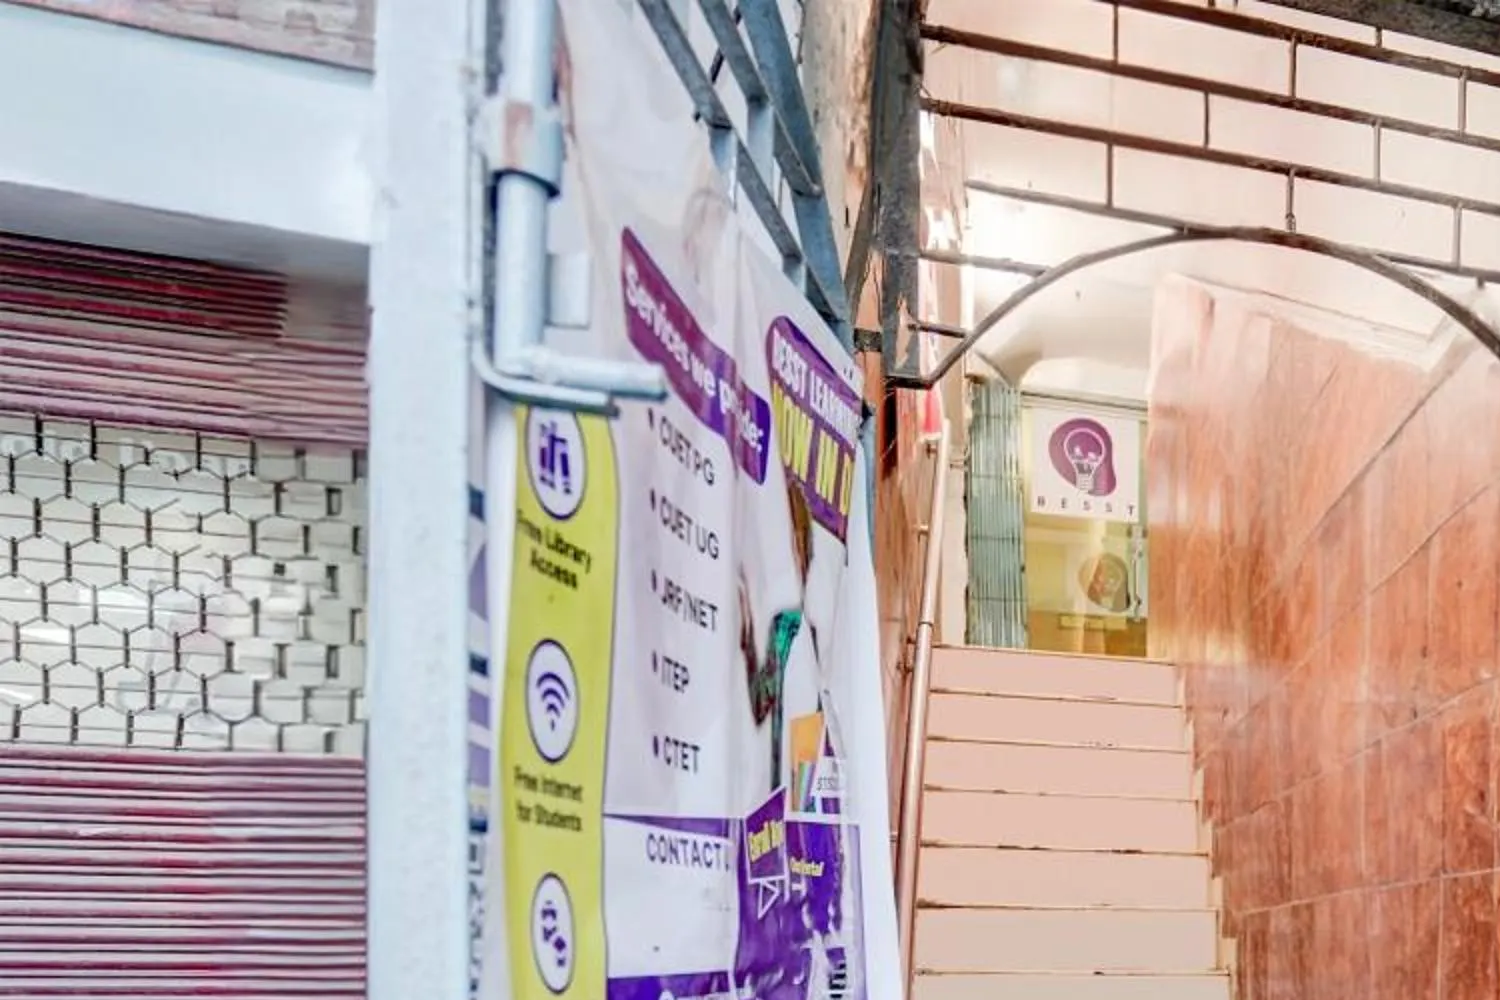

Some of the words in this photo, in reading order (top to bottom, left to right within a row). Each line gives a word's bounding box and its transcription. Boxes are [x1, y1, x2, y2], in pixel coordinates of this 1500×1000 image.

[625, 262, 690, 373] Services
[690, 350, 717, 399] we
[694, 449, 715, 486] PG
[660, 495, 693, 545] CUET
[695, 522, 719, 560] UG
[663, 735, 701, 774] CTET
